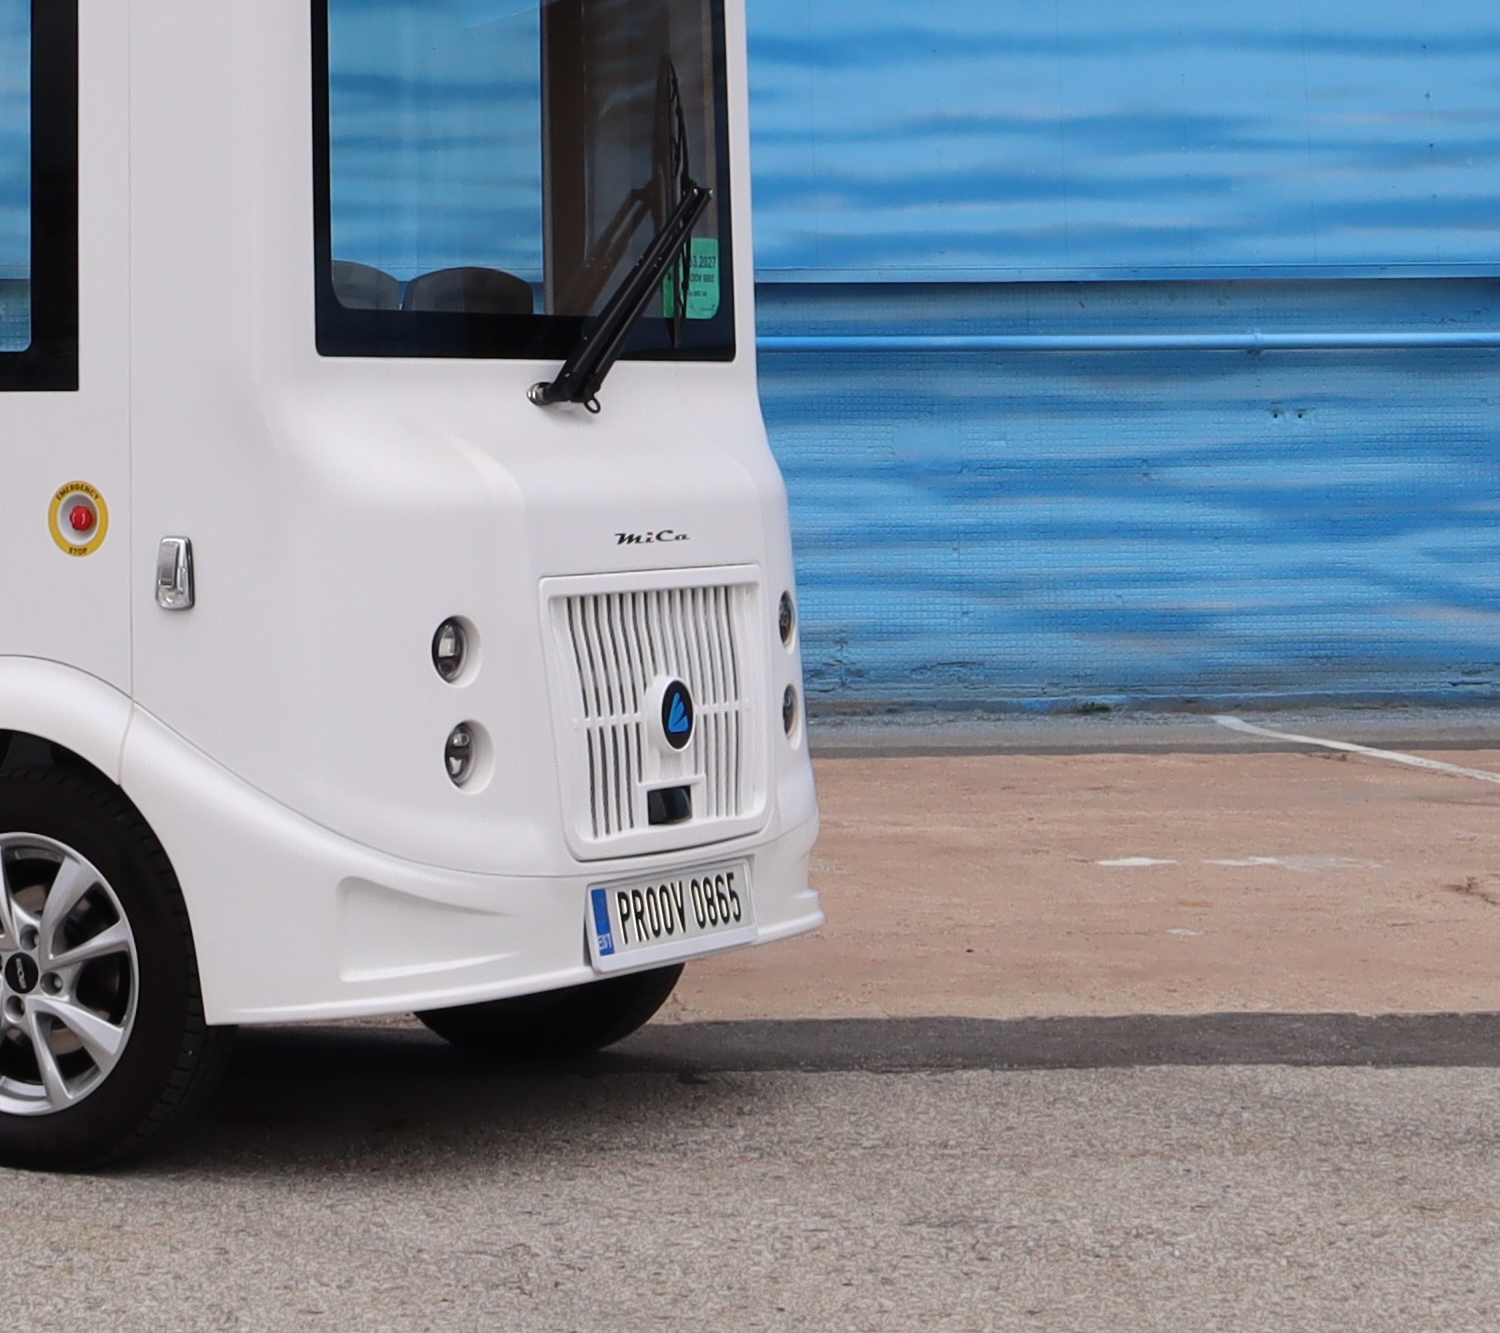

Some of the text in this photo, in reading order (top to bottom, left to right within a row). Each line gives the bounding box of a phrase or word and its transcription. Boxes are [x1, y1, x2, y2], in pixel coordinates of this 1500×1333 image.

[55, 483, 100, 501] EMERGENCY
[68, 546, 87, 555] STOP
[689, 871, 742, 929] 0865
[598, 933, 613, 950] EST
